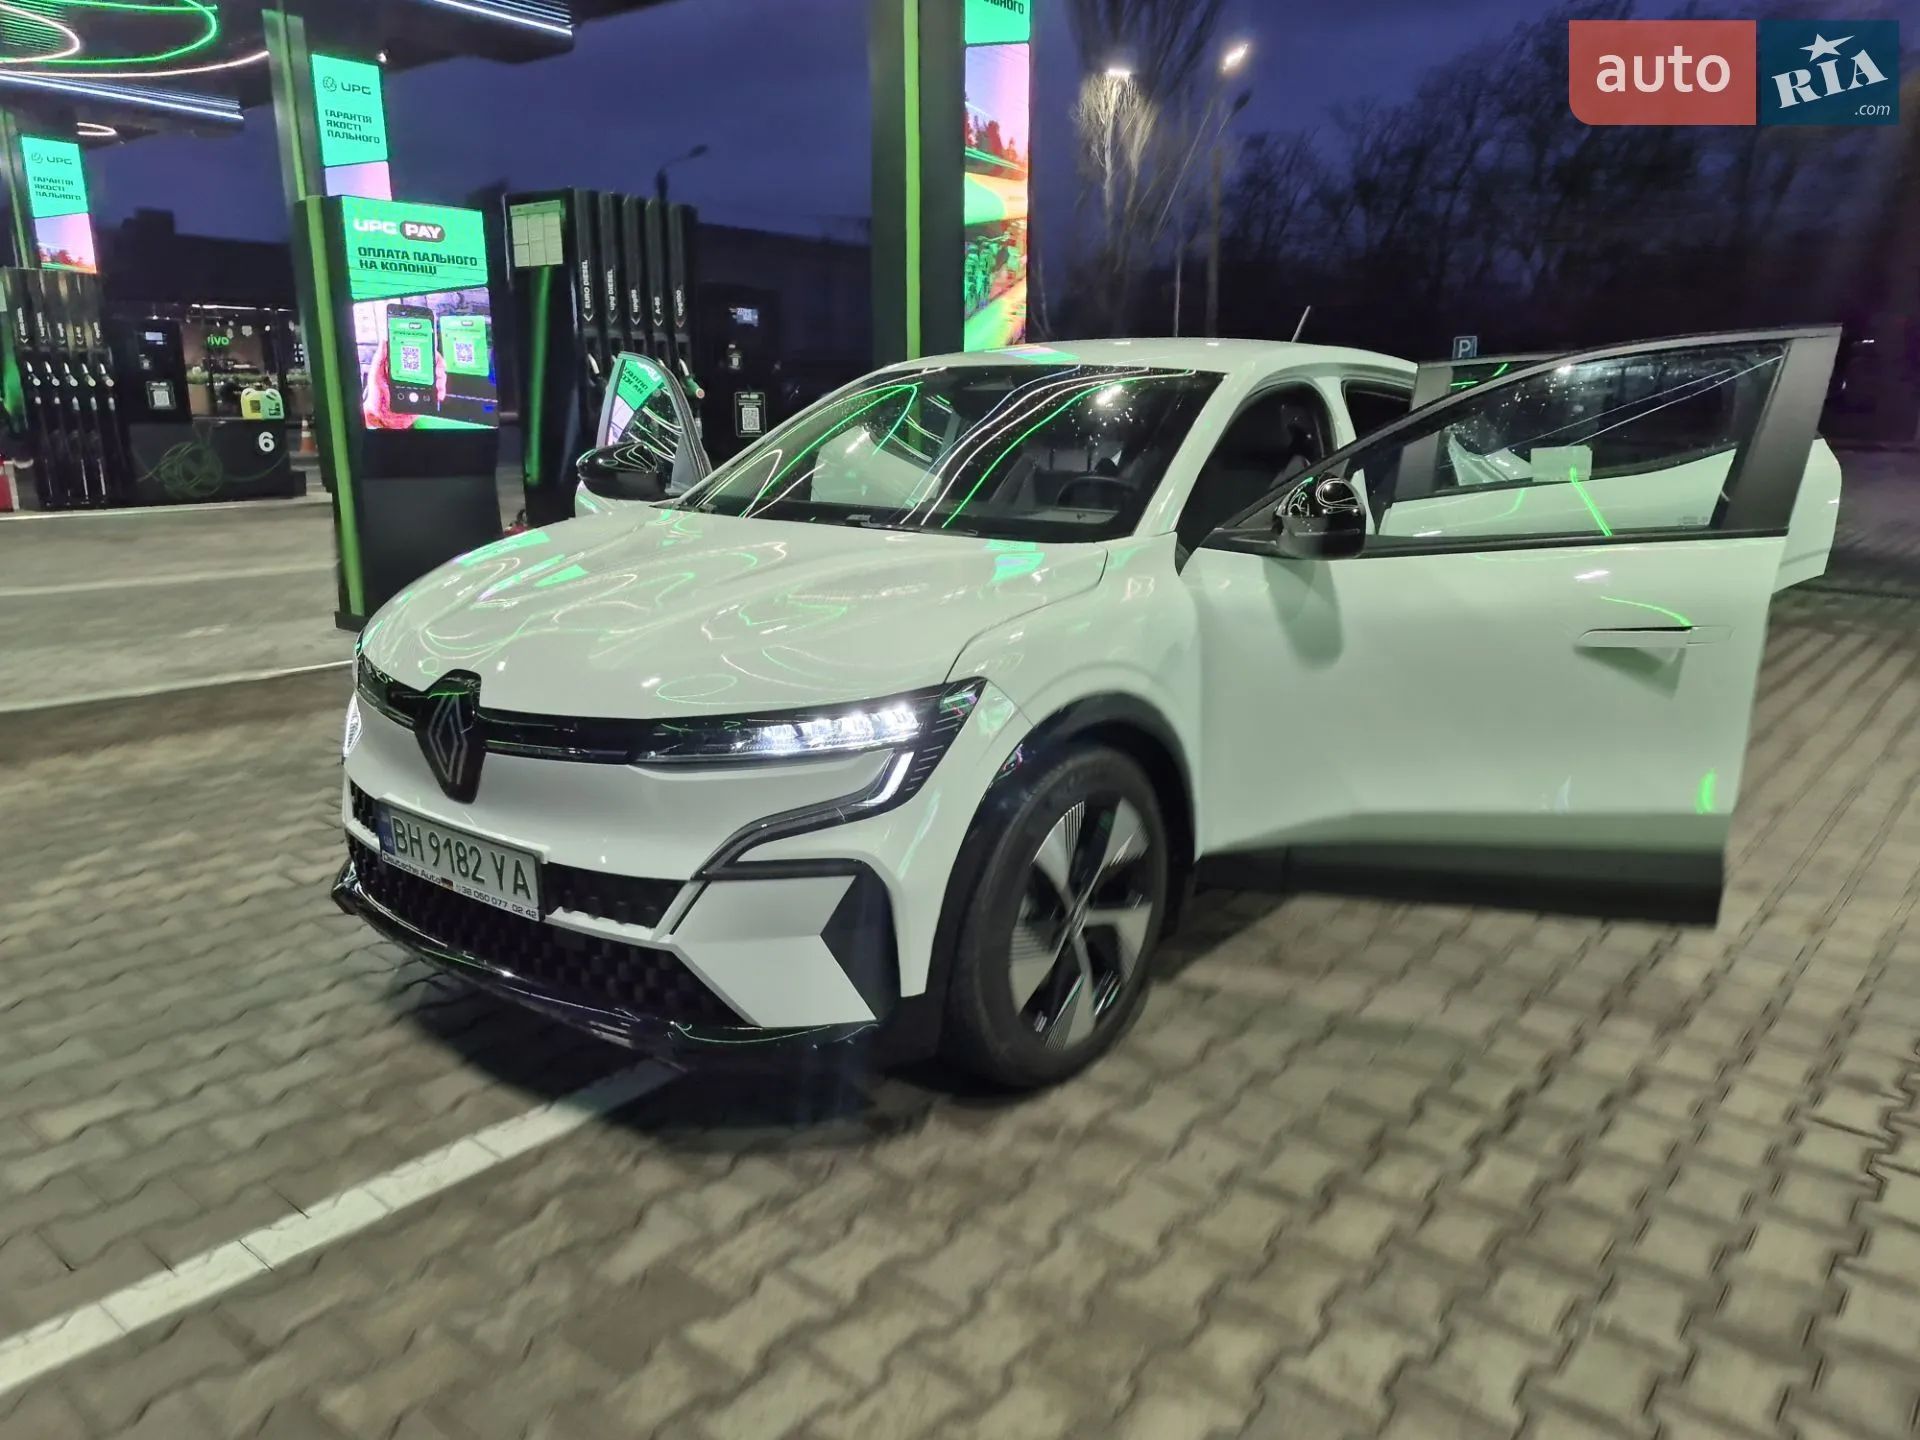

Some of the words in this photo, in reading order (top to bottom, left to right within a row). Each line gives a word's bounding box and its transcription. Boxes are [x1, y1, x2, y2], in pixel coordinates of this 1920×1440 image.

[341, 82, 371, 95] UPG
[325, 109, 372, 124] ГАРАНТІЯ
[326, 119, 361, 132] ЯКОСТІ
[327, 129, 380, 144] ПАЛЬНОГО
[46, 156, 72, 165] UPG
[353, 218, 397, 235] UPG
[404, 223, 441, 239] PAY
[357, 246, 410, 261] ОПЛАТА
[413, 251, 478, 267] ПАЛЬНОГО
[359, 259, 378, 270] НА
[581, 260, 589, 286] DIESEL
[1458, 339, 1471, 358] P
[258, 431, 275, 452] 6
[391, 816, 424, 862] BH
[428, 831, 486, 884] 9182
[490, 851, 531, 900] YA
[420, 869, 442, 884] Auto
